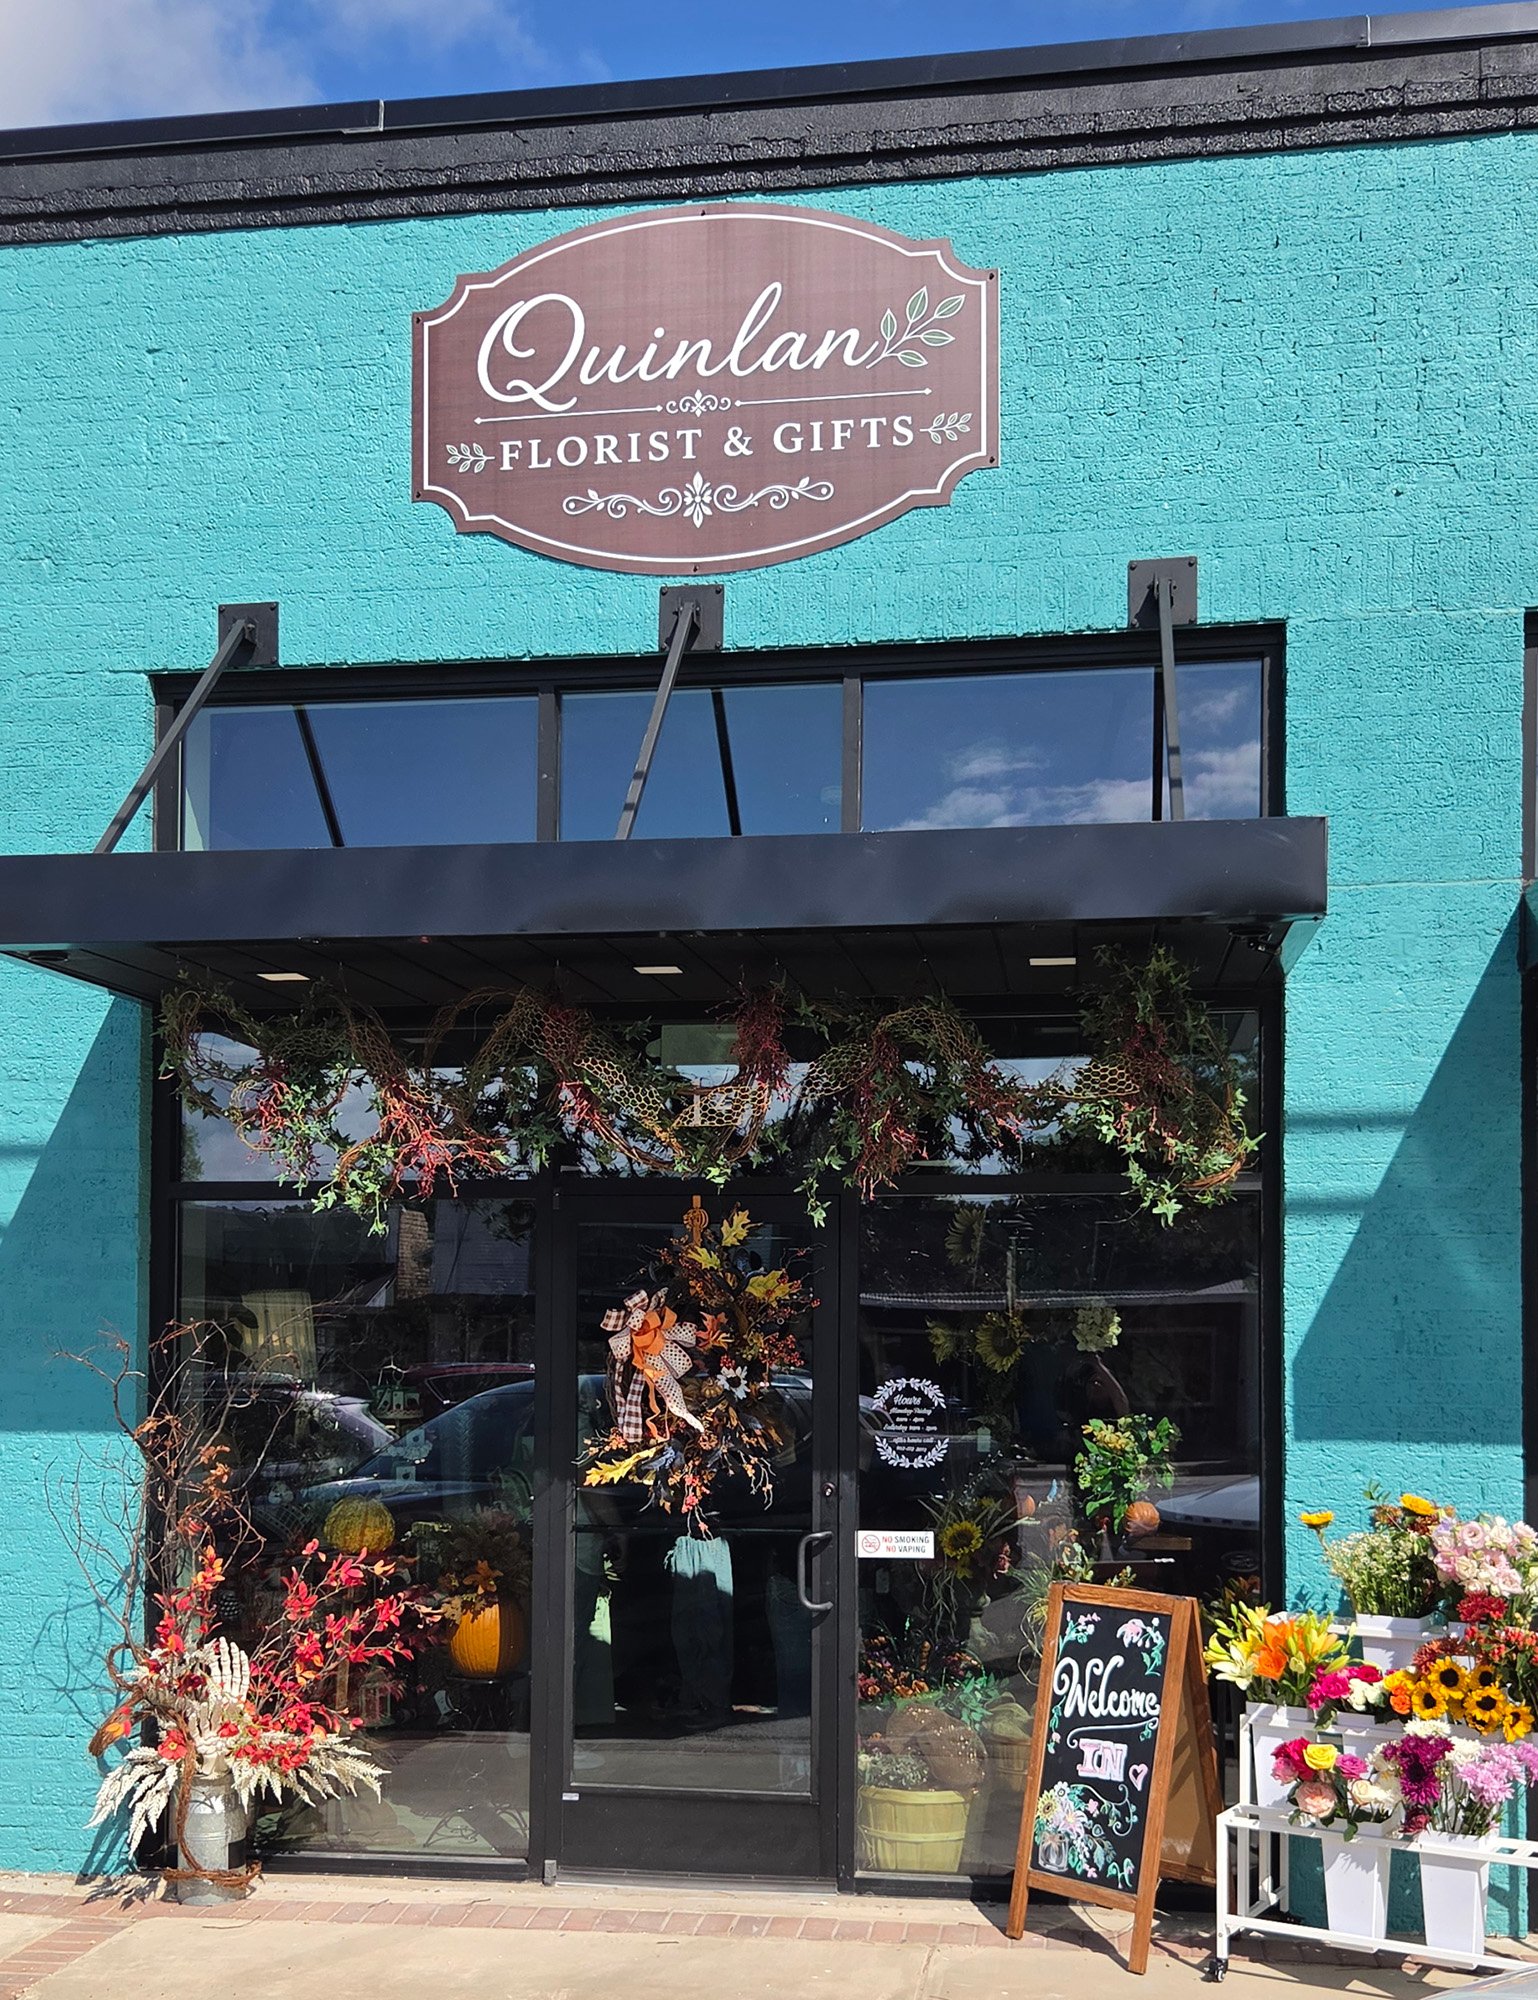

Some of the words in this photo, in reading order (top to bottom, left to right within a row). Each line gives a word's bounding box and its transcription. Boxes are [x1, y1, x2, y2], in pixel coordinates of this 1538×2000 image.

[477, 282, 880, 412] Quinlan
[500, 428, 703, 471] FLORIST
[724, 426, 754, 456] &
[773, 415, 916, 453] GIFTS
[893, 1394, 922, 1406] Hours
[894, 1536, 930, 1544] SMOKING
[1053, 1655, 1161, 1718] Welcome
[1076, 1737, 1128, 1782] IN
